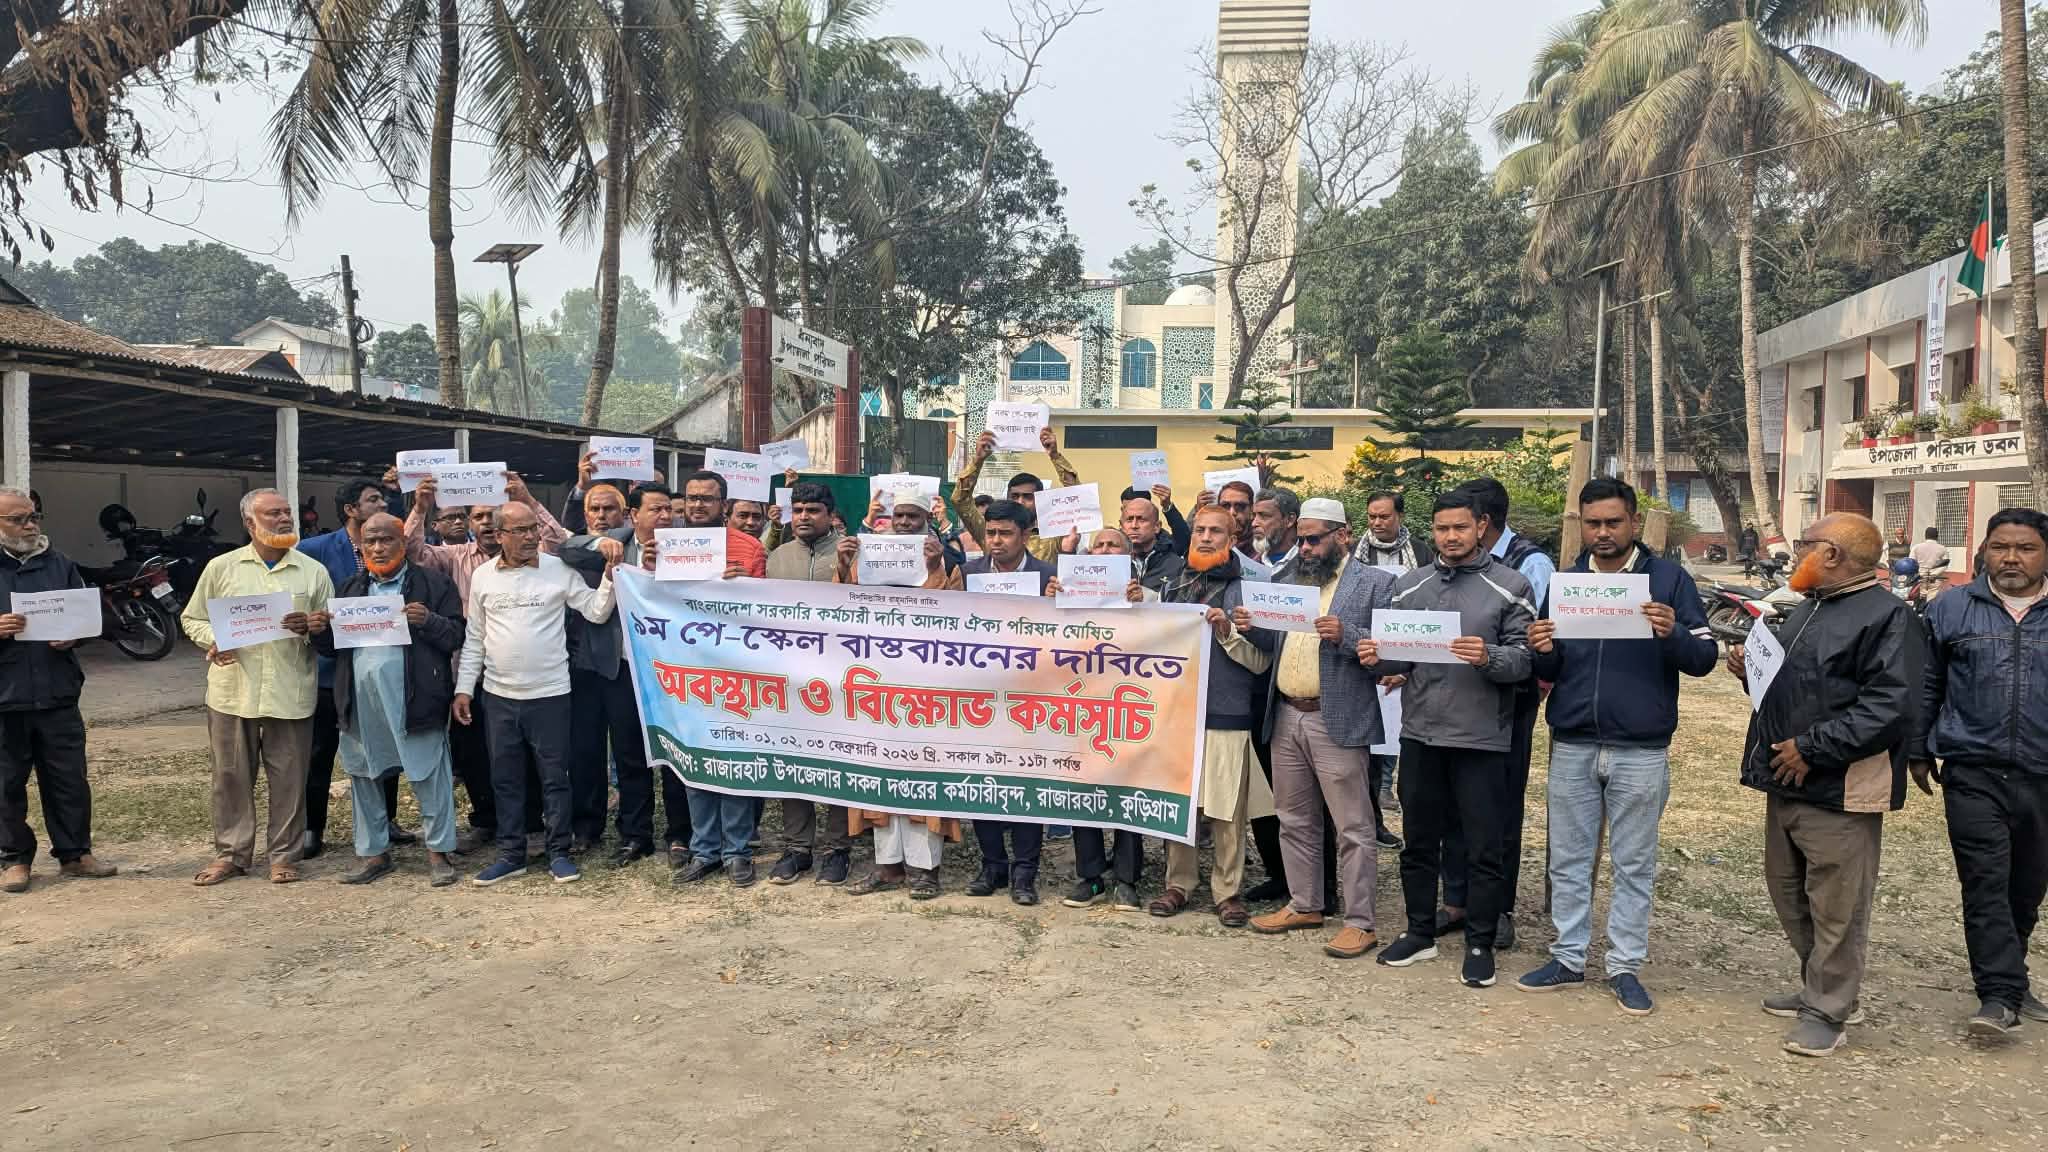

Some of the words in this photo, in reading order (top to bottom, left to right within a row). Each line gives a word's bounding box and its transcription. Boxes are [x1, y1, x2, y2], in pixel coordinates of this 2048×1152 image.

[1869, 444, 1917, 464] উপজেলা
[1926, 438, 1977, 459] পরিষদ
[1982, 436, 2021, 455] ভবন
[679, 538, 712, 548] পে-স্কেল
[884, 543, 917, 553] পে-স্কেল
[864, 560, 898, 569] বাস্তবায়ন
[901, 559, 916, 569] চাই
[1563, 585, 1581, 598] ৯ম
[1584, 586, 1629, 600] পে-স্কেল
[1269, 593, 1304, 607] পে-স্কেল
[229, 603, 267, 615] পে-স্কেল
[356, 606, 390, 617] পে-স্কেল
[682, 597, 751, 618] বাংলাদেশ
[756, 600, 812, 622] সরকারি
[816, 605, 870, 625] কর্মচারী
[874, 606, 906, 628] দাবি
[911, 613, 960, 632] আদায়
[964, 612, 1001, 634] ঐক্য
[1006, 616, 1059, 638] পরিষদ
[1062, 619, 1116, 642] ঘোষিত
[1384, 622, 1401, 633] ৯ম
[1402, 623, 1442, 635] পে-স্কেল
[630, 611, 672, 641] ৯ম
[680, 620, 828, 656] পে-স্কেল
[836, 633, 1045, 672] বাস্তবায়নের
[1050, 642, 1190, 680] দাবিতে
[652, 658, 790, 720] অবস্থান
[798, 676, 834, 717] ও
[840, 663, 998, 729] বিক্ষোভ
[1004, 677, 1158, 764] কর্মসূচি
[709, 727, 750, 742] তারিখ:
[754, 733, 776, 746] ০১,
[780, 734, 802, 749] ০২,
[806, 738, 825, 750] ০৩
[828, 738, 878, 758] ফেব্রুয়ারি
[882, 747, 919, 762] ২০২৬
[922, 745, 941, 764] খ্রি.
[945, 750, 981, 766] সকাল
[1018, 754, 1048, 770] ১১টা
[1052, 756, 1082, 772] পর্যন্ত
[703, 756, 769, 784] রাজারহাট
[773, 755, 841, 791] উপজেলার
[846, 770, 881, 797] সকল
[887, 776, 937, 801] দপ্তরের
[943, 775, 1032, 813] কর্মচারীবৃন্দ,
[1035, 786, 1114, 818] রাজারহাট,
[1119, 790, 1180, 825] কুড়িগ্রাম
